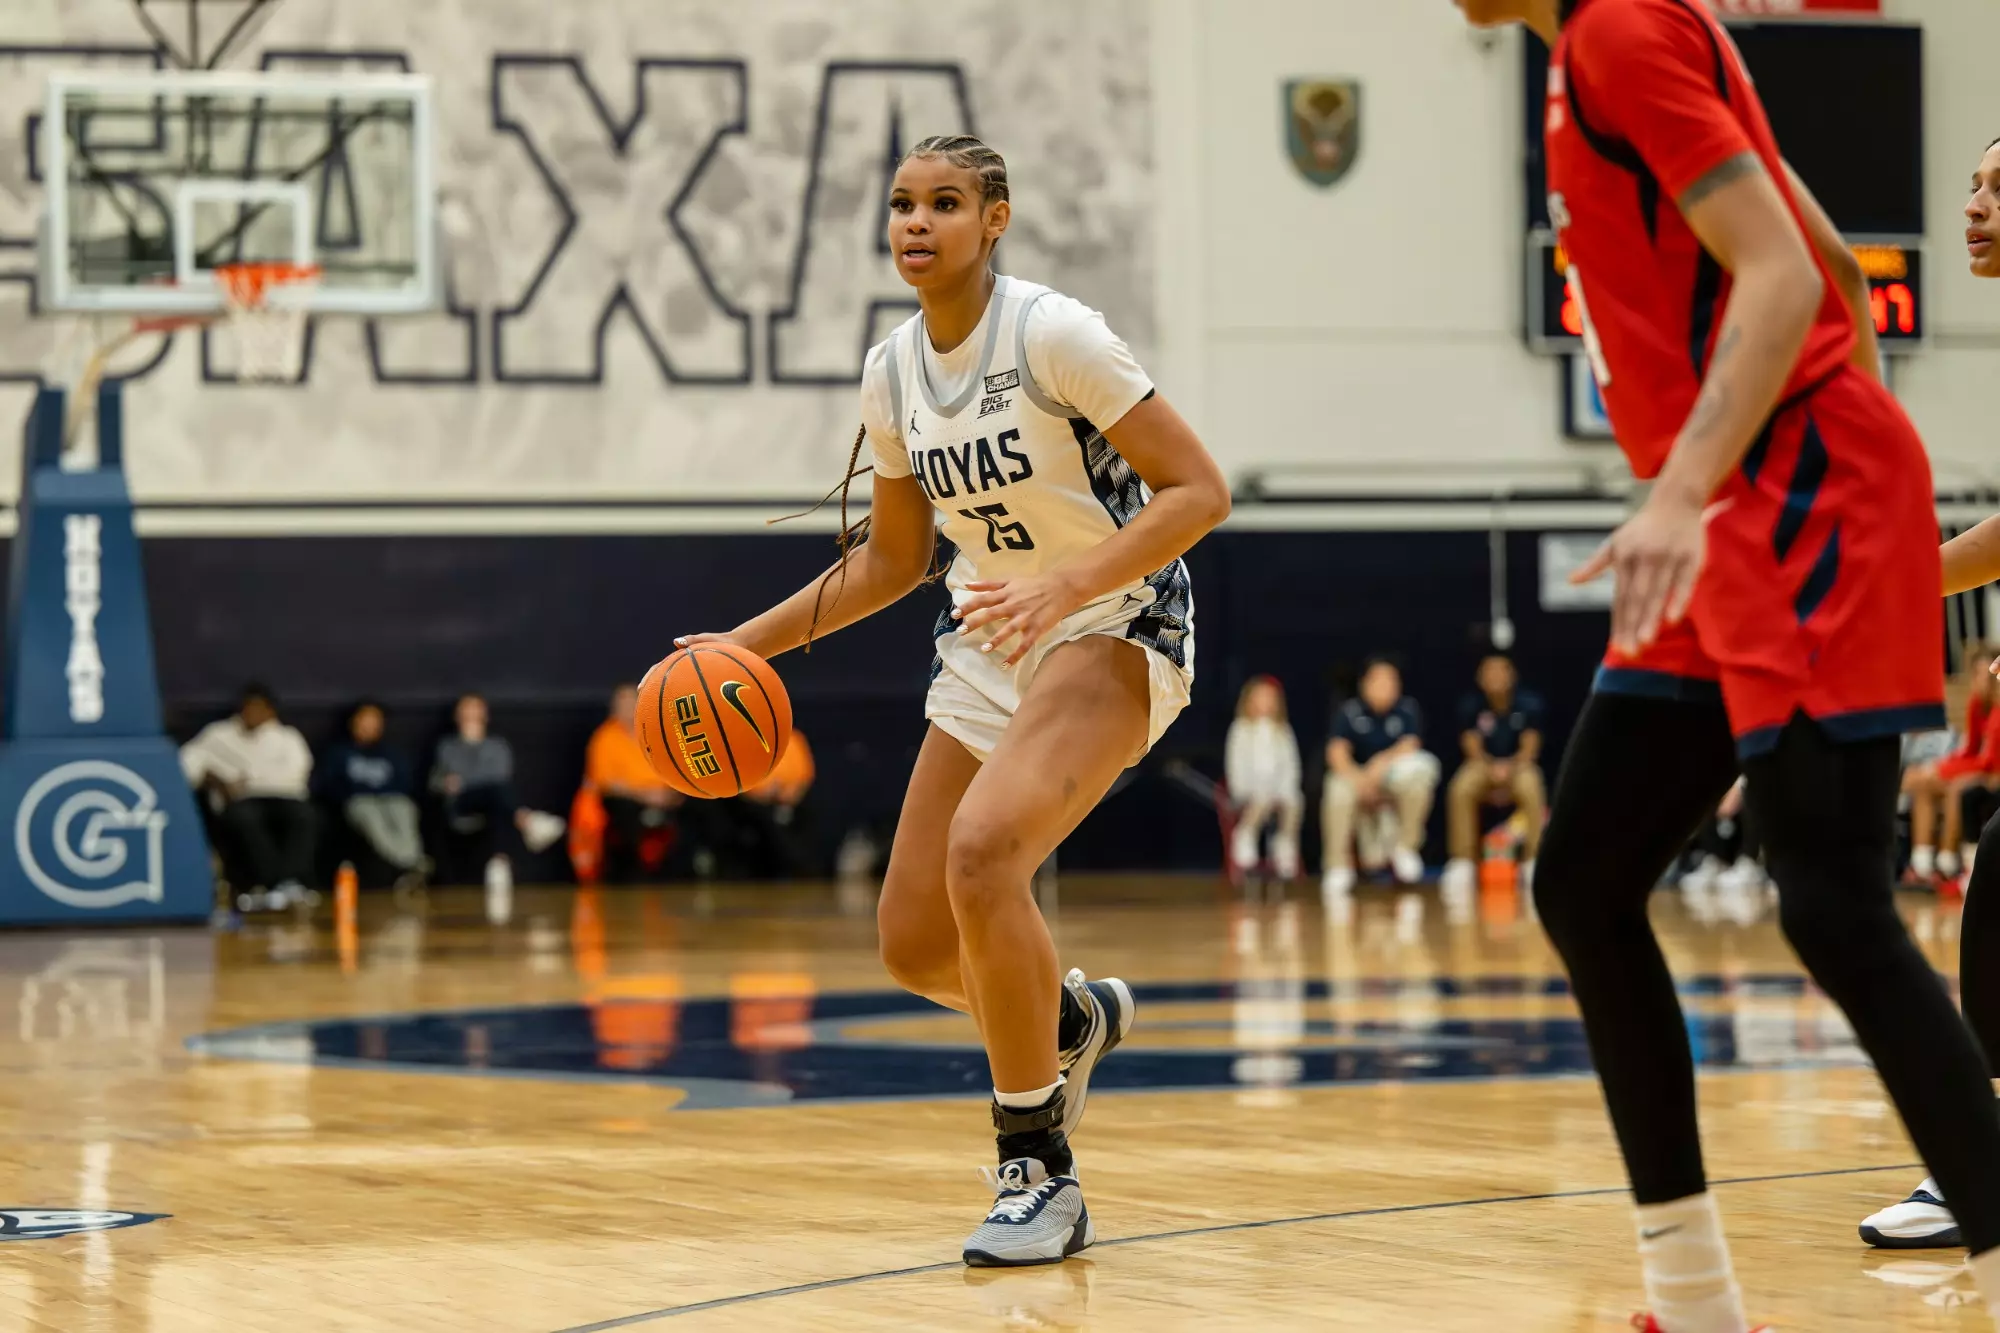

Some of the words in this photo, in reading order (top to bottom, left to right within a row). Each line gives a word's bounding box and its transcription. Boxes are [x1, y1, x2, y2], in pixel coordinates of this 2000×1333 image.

[980, 399, 1012, 415] EAST
[981, 394, 1003, 407] BIG
[911, 427, 1034, 500] HOYAS
[957, 502, 1035, 553] 15
[63, 513, 105, 723] HOYAS
[668, 700, 700, 779] CHMPIONSHIP
[675, 693, 722, 777] ELITE
